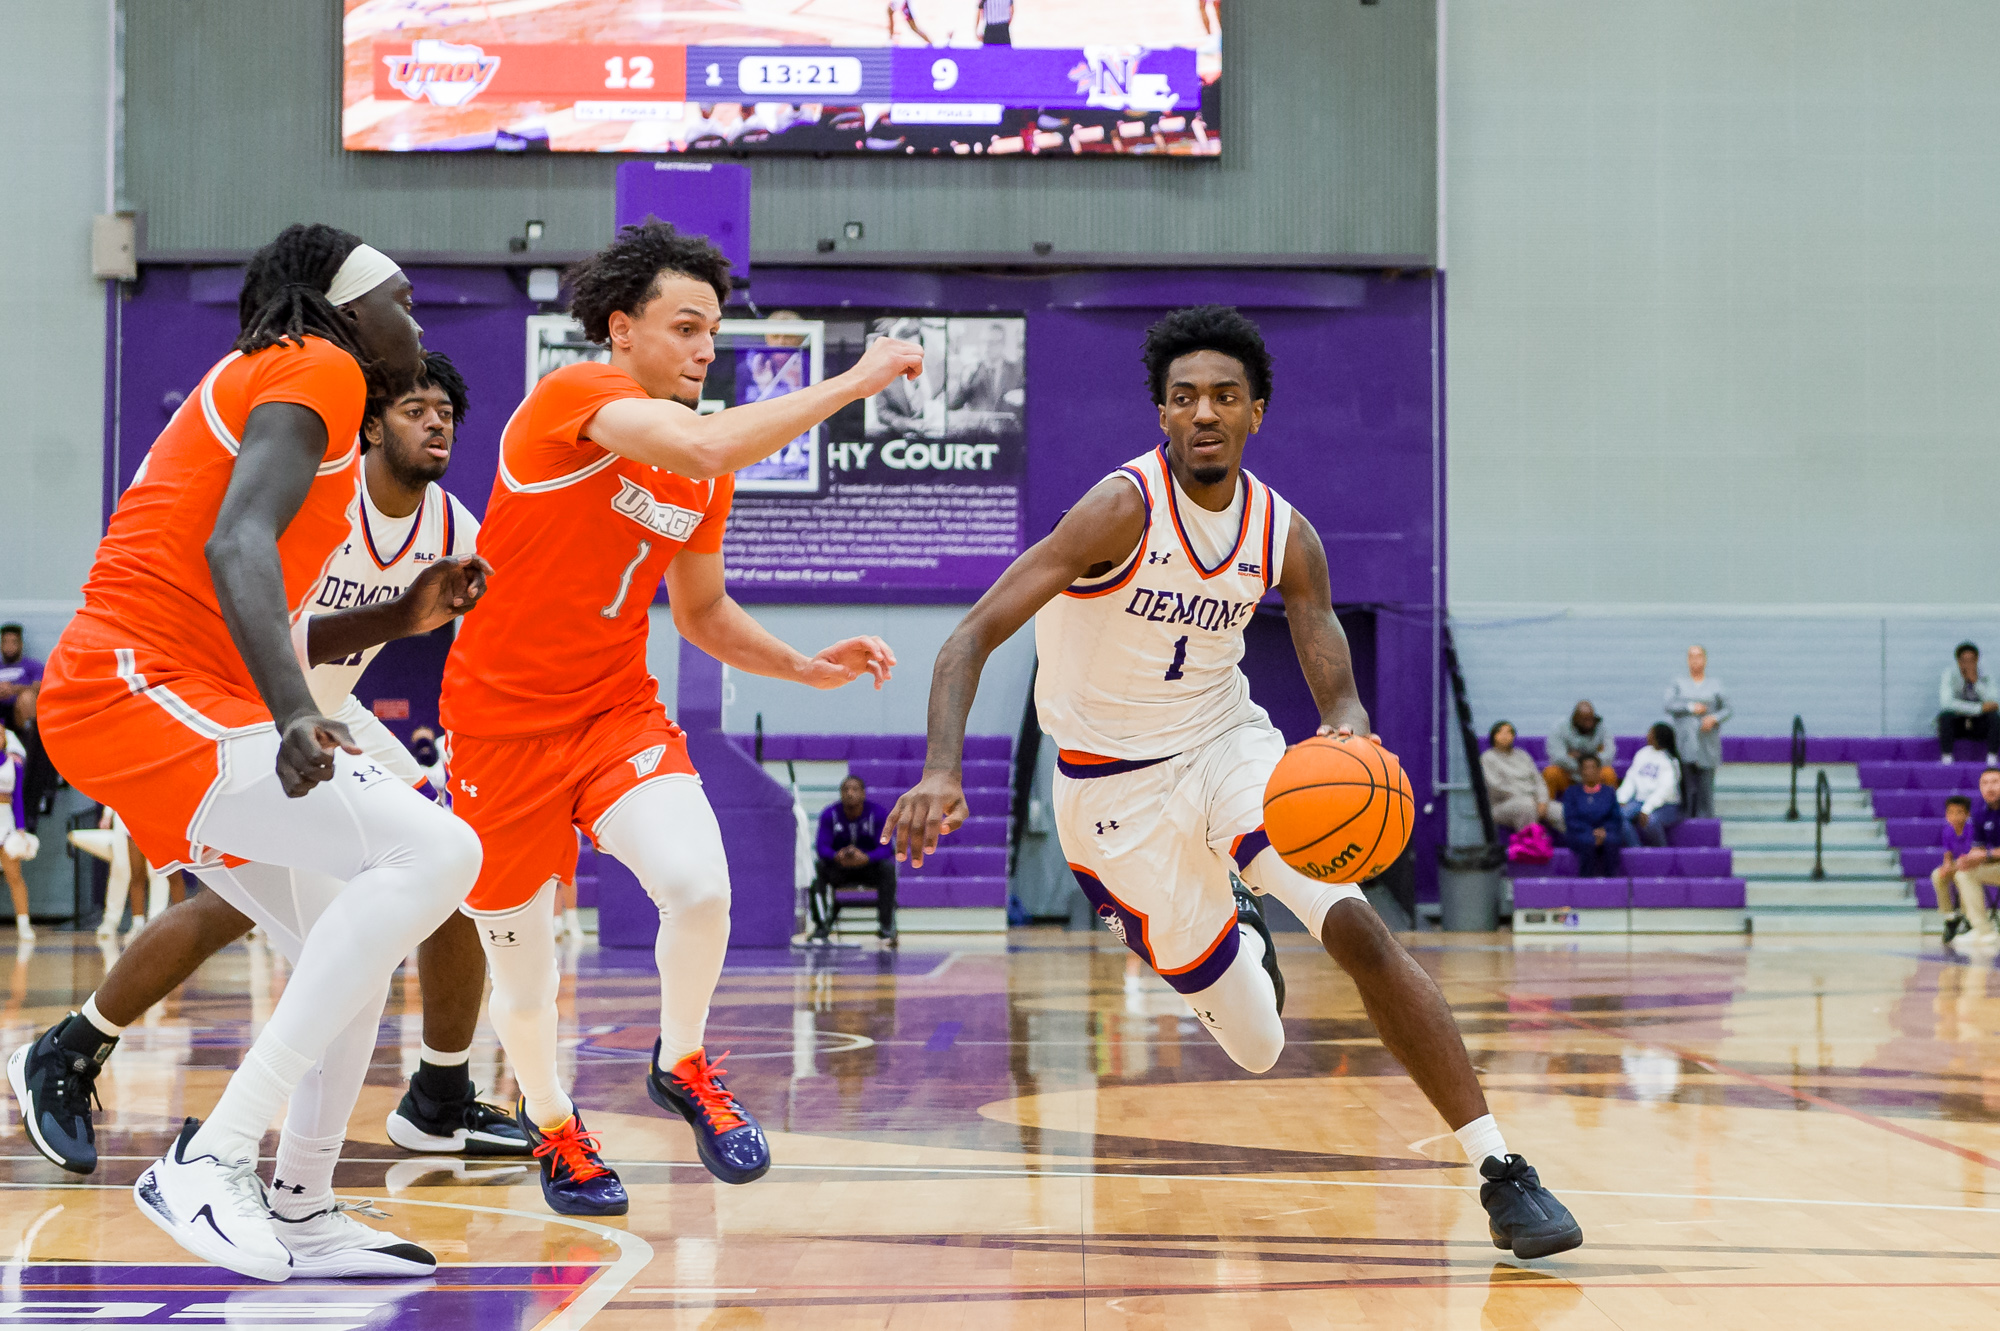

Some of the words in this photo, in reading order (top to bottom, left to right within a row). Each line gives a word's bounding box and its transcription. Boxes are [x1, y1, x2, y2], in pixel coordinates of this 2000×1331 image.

[605, 57, 655, 89] 12
[705, 63, 722, 87] 1
[758, 64, 840, 85] 13:21
[931, 58, 959, 91] 9
[1096, 58, 1132, 96] N
[880, 439, 1000, 471] COURT
[600, 539, 652, 620] 1
[1164, 635, 1189, 681] 1
[1293, 842, 1364, 879] ilson
